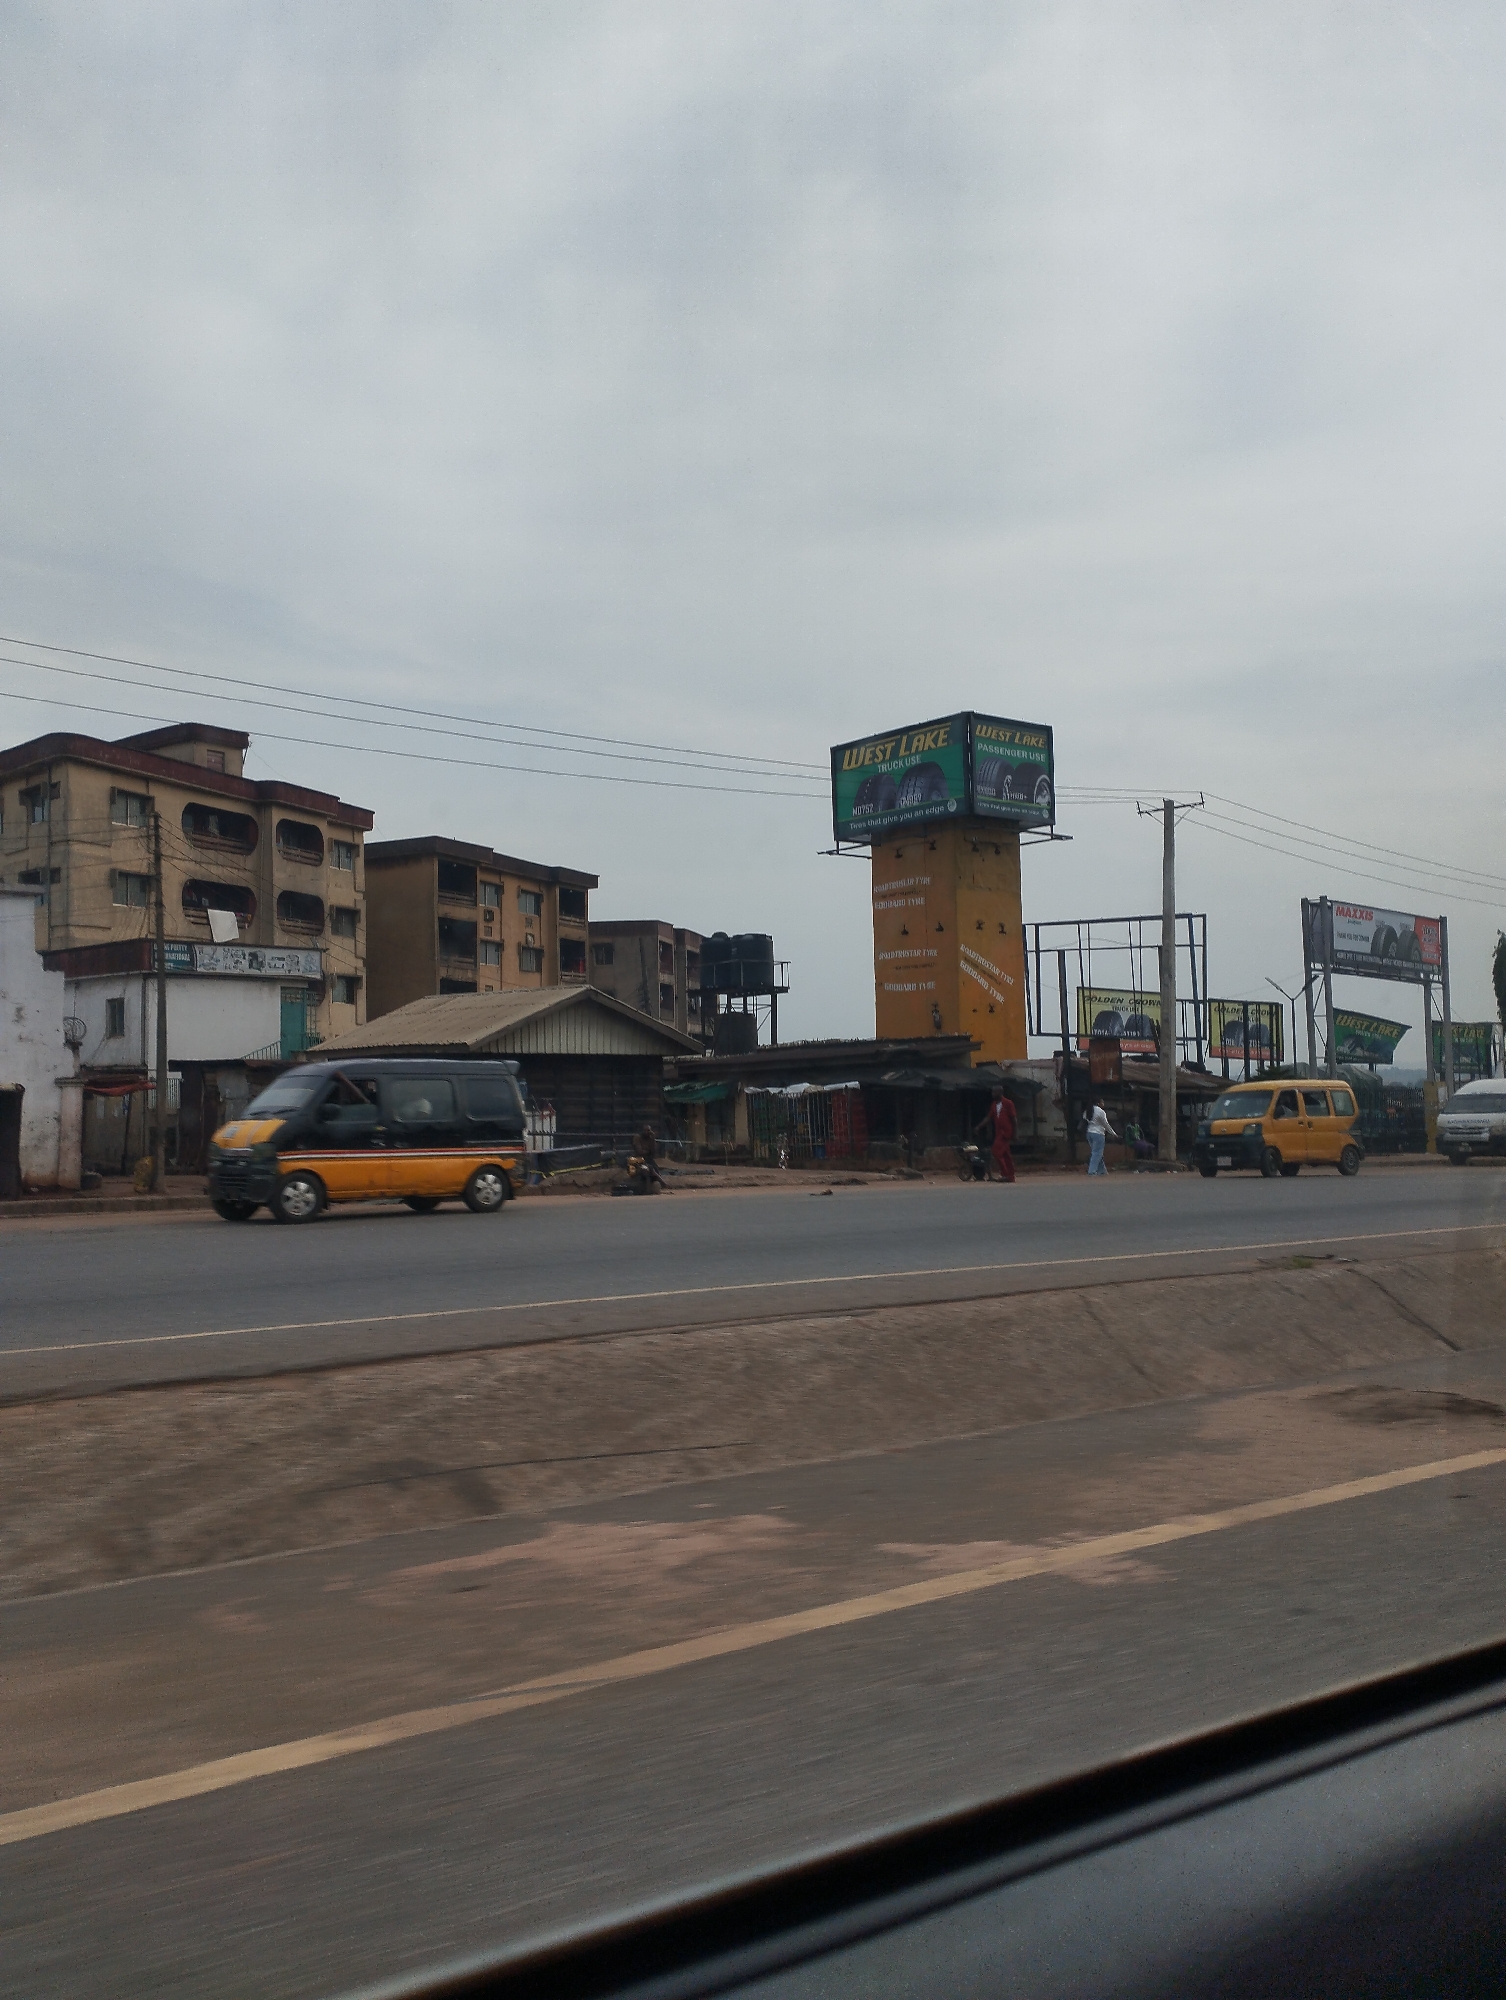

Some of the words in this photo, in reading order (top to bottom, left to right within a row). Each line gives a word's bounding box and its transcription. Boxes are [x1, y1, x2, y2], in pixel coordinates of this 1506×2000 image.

[975, 724, 1012, 743] WEST
[1014, 731, 1046, 749] LAKE
[842, 739, 897, 771] WEST
[899, 727, 950, 757] LAKE
[977, 742, 1028, 760] PASSENGER
[1029, 752, 1046, 763] USE
[878, 759, 904, 773] TRUCK
[905, 755, 922, 768] USE
[899, 812, 913, 821] you
[914, 808, 924, 816] an
[925, 804, 945, 816] edge
[915, 876, 932, 886] TYRE
[908, 897, 926, 907] TYRE
[1335, 905, 1374, 921] MAXXIS
[922, 948, 938, 957] TYRE
[918, 981, 936, 990] TYRE
[989, 986, 1005, 1005] TYRE
[1083, 995, 1125, 1005] GOLDEN
[1336, 1013, 1370, 1031] WEST
[1370, 1021, 1401, 1039] LAKE
